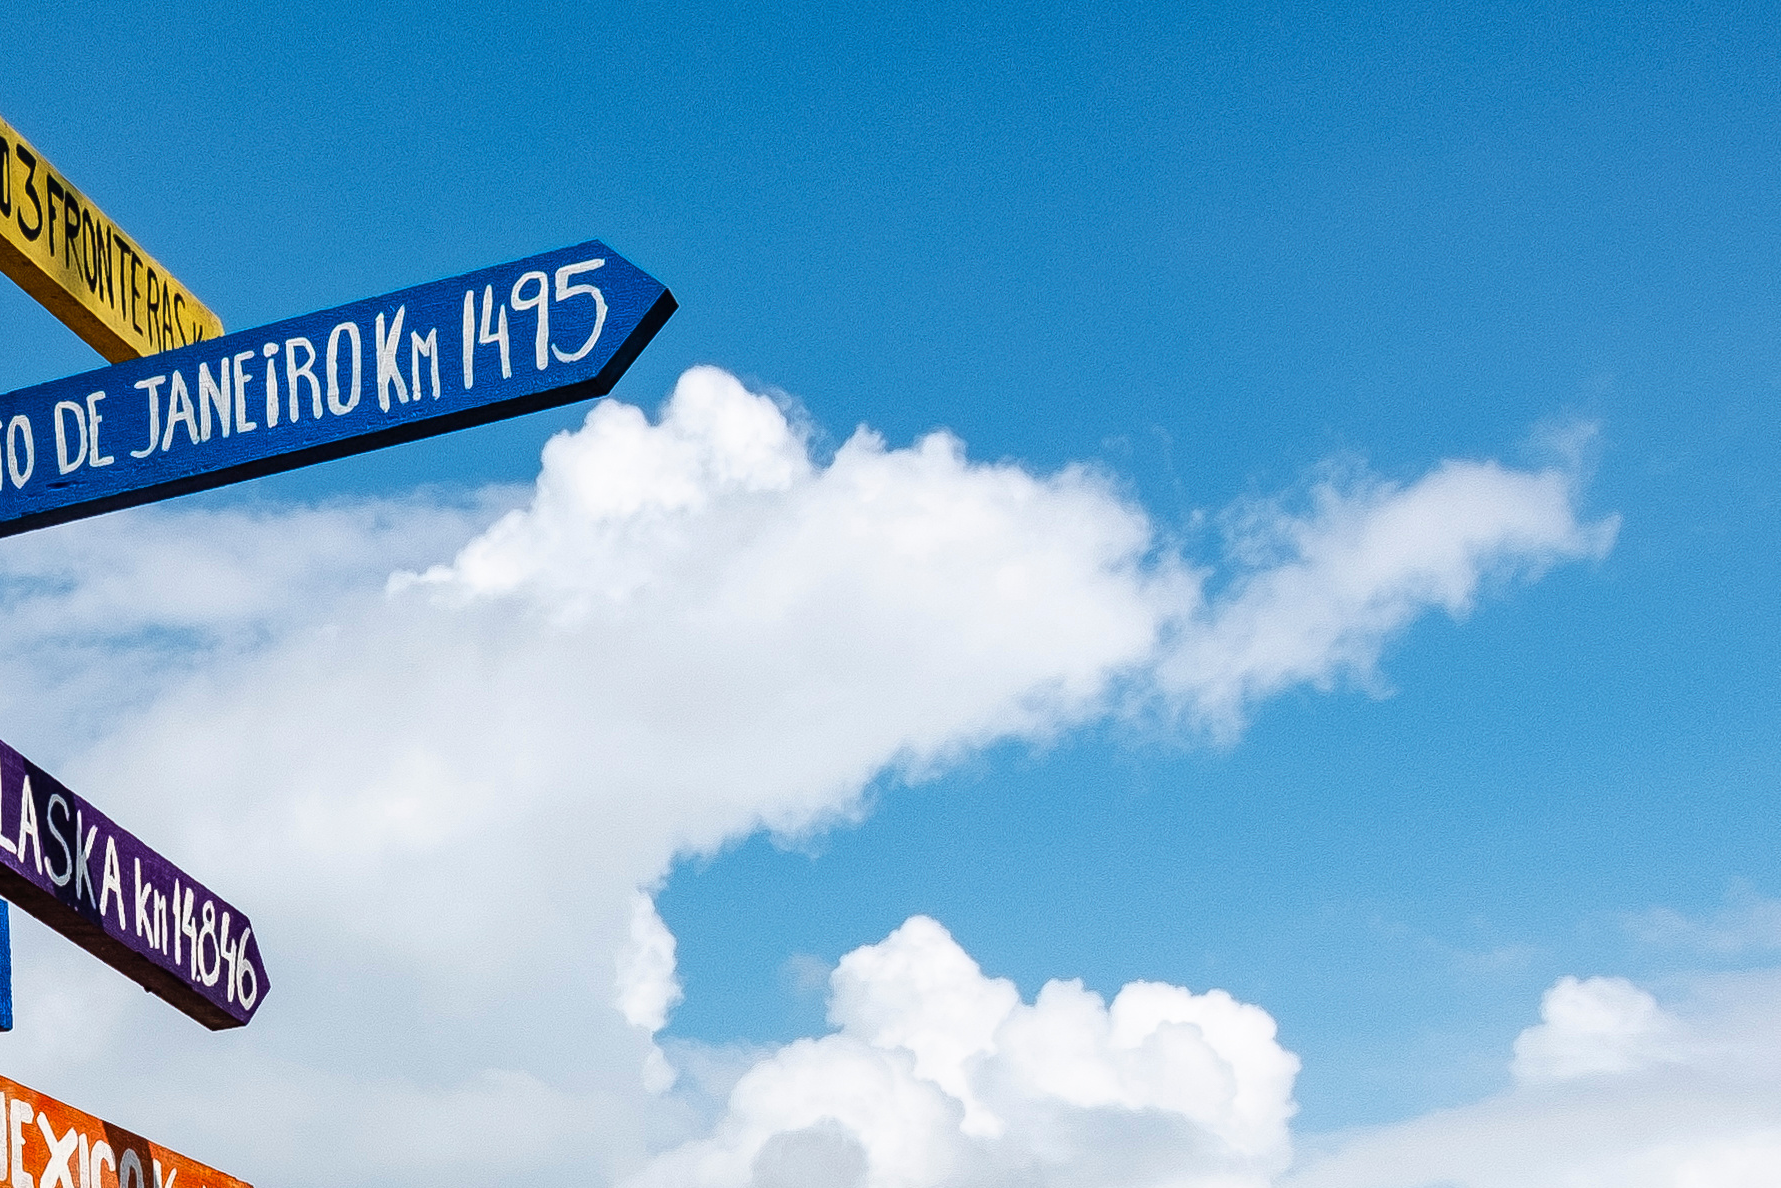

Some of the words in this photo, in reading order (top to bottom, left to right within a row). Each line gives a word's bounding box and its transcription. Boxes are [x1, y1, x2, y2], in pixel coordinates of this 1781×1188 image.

[16, 142, 44, 241] 3
[54, 390, 115, 477] DE
[463, 257, 610, 391] 1495
